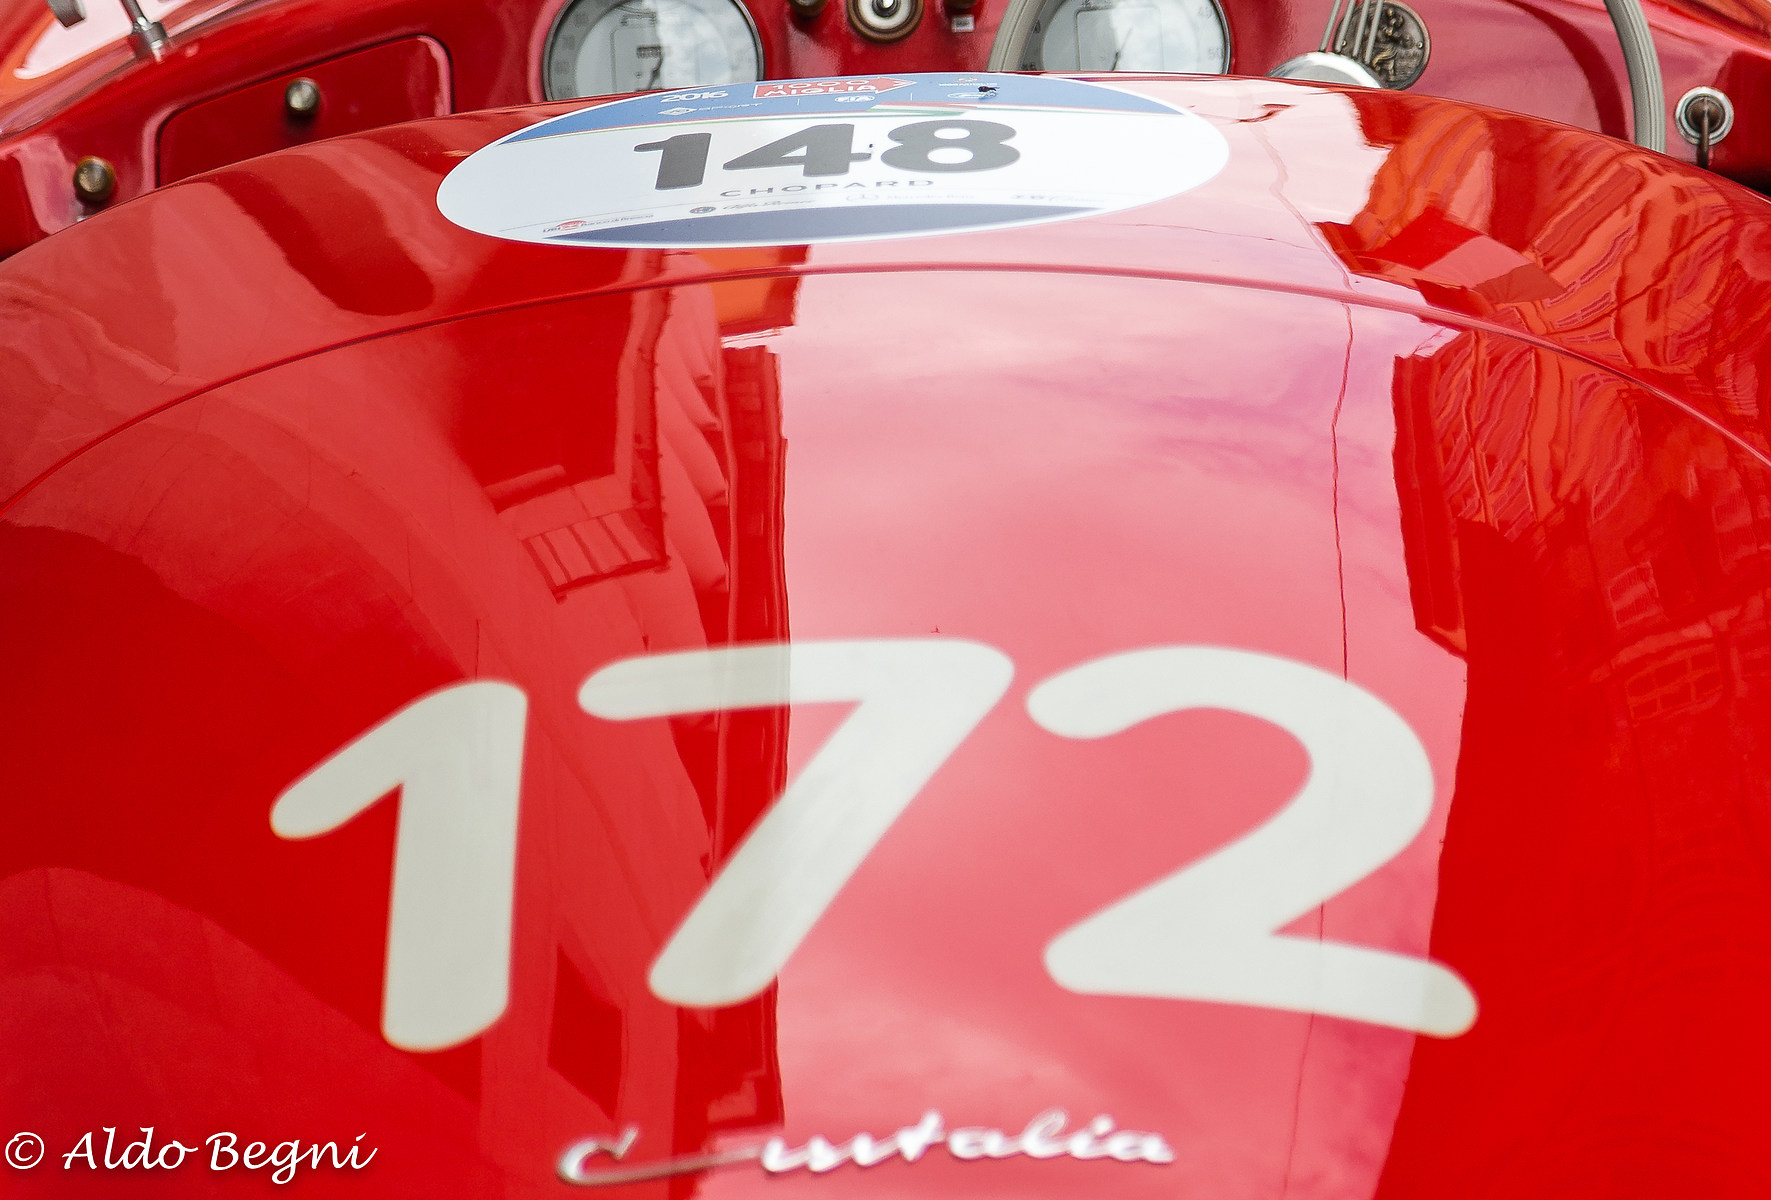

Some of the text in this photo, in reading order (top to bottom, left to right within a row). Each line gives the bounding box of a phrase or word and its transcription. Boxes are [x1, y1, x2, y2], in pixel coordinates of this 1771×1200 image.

[763, 82, 877, 98] MIGLIA
[774, 79, 870, 91] 1000
[660, 90, 729, 103] 2016
[633, 119, 1023, 191] 148
[719, 179, 935, 198] CHOPARD
[269, 637, 1479, 1052] 172
